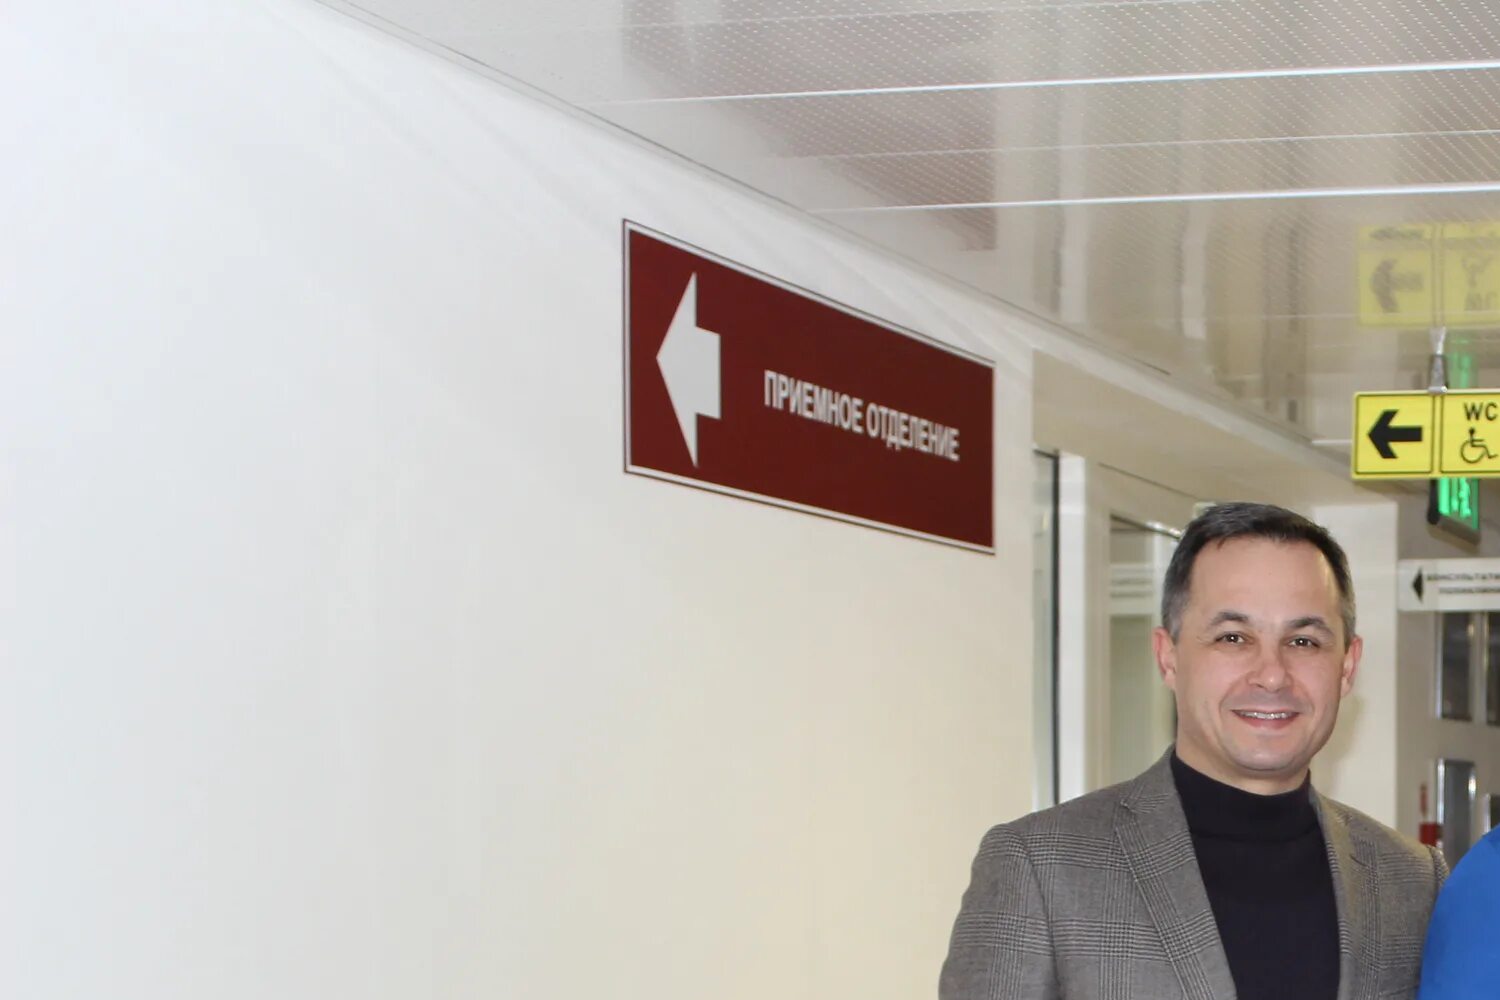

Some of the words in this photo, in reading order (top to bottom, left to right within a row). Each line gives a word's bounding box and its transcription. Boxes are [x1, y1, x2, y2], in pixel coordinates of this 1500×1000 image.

[764, 369, 863, 434] ПРИЕМНОЕ
[866, 402, 960, 462] ОТДЕЛЕНИЕ
[1463, 402, 1498, 421] WC
